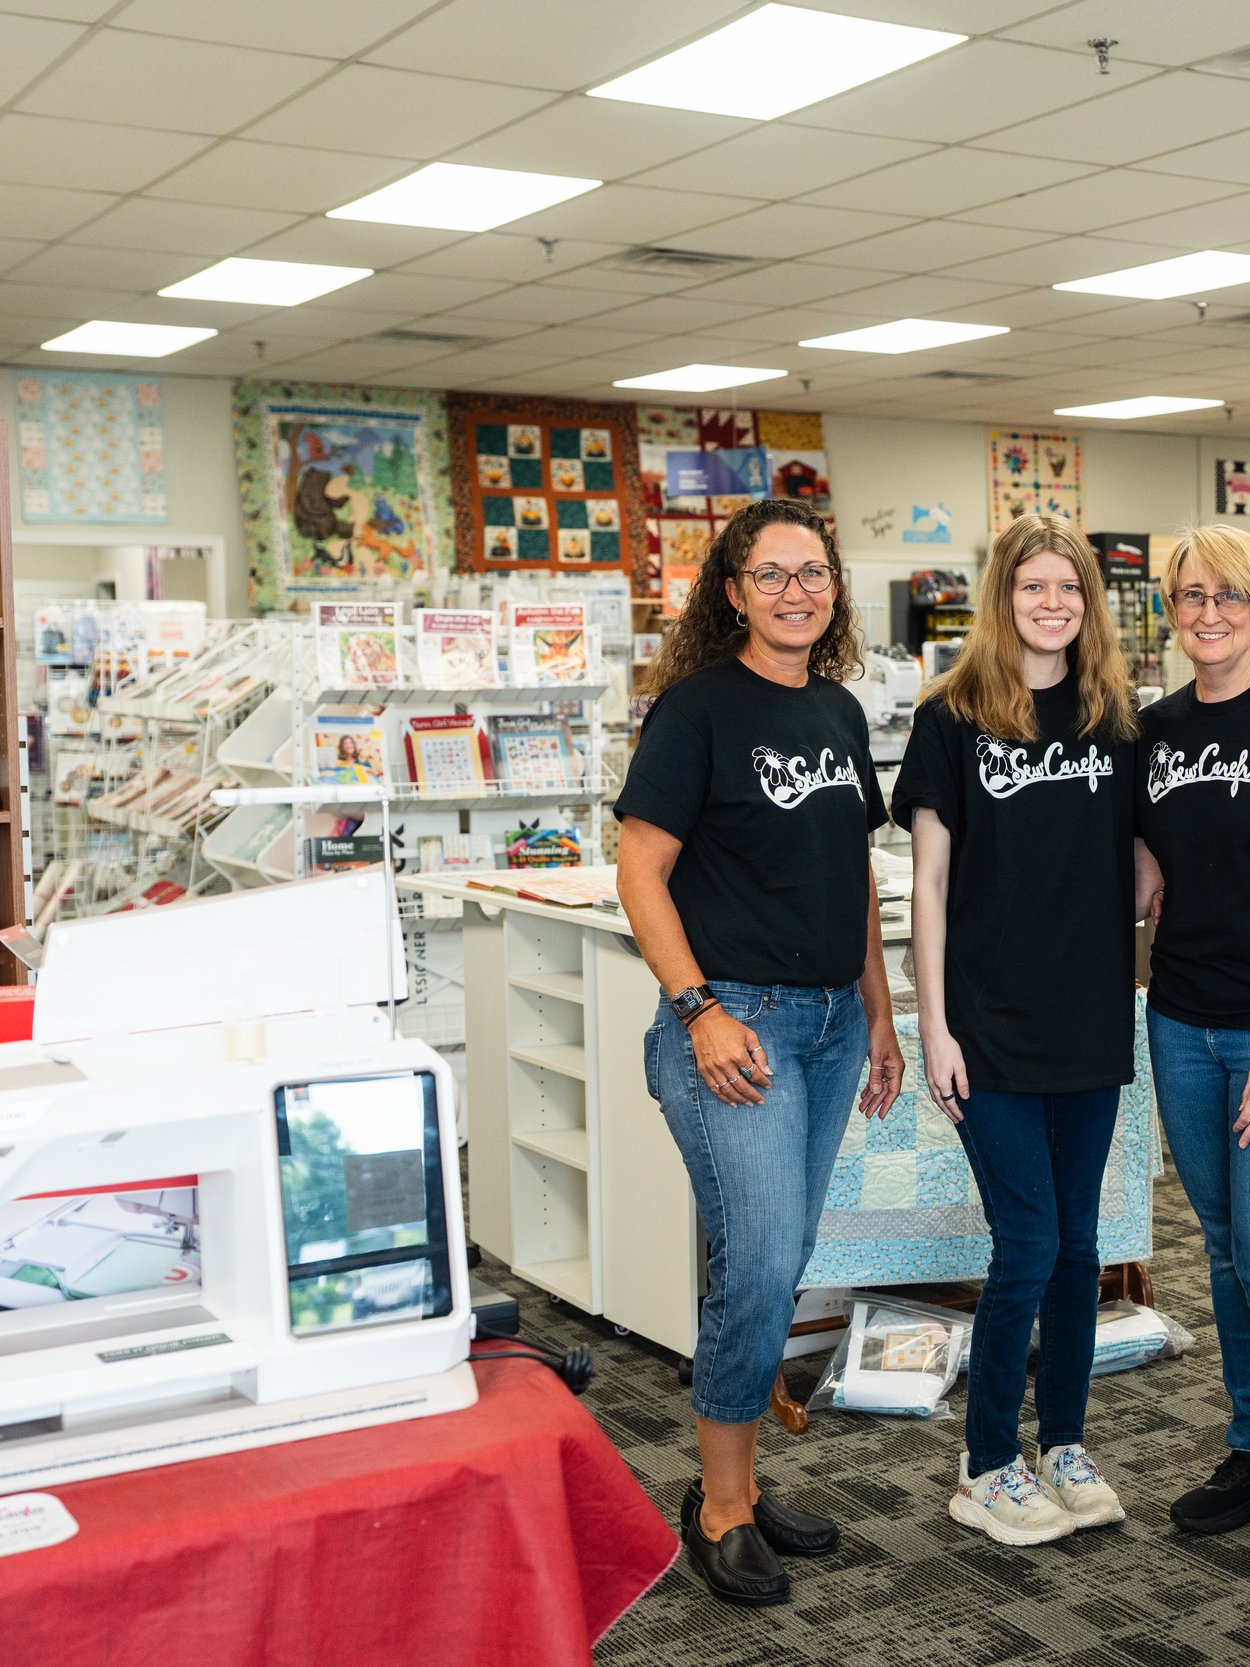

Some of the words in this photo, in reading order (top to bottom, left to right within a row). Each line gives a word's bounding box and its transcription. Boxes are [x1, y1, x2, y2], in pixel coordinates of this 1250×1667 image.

[788, 756, 821, 793] Sew
[1009, 748, 1044, 784] Sew
[1044, 742, 1113, 793] Carefre
[1165, 751, 1199, 788] Sew
[321, 840, 354, 851] Home
[519, 845, 570, 857] Stunning
